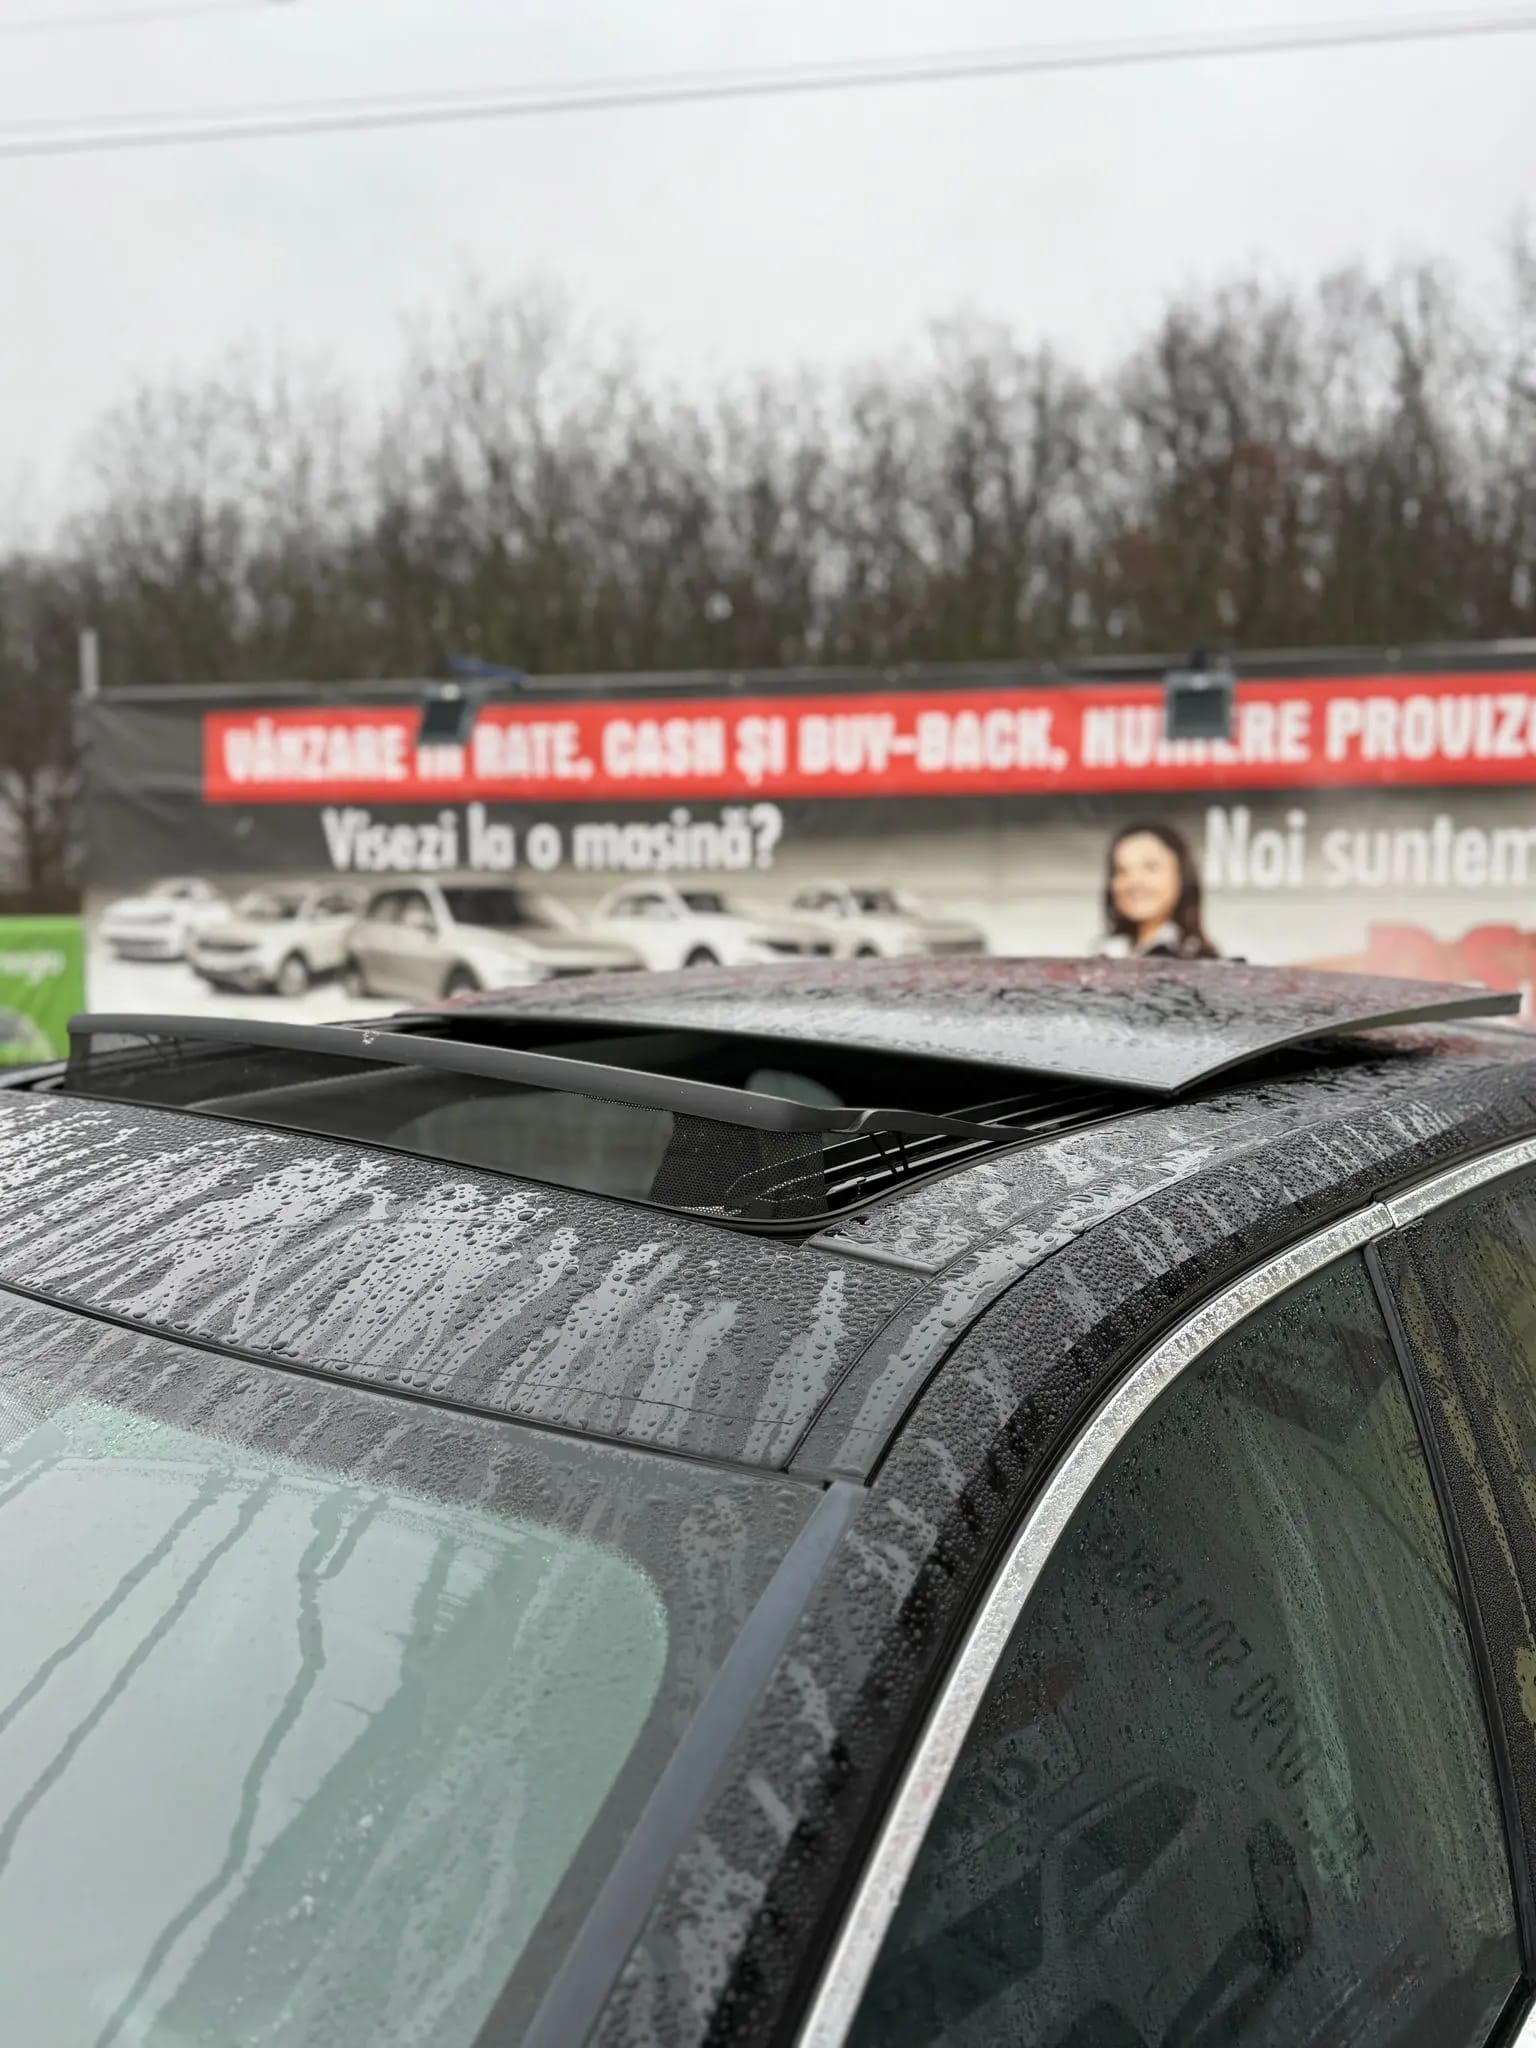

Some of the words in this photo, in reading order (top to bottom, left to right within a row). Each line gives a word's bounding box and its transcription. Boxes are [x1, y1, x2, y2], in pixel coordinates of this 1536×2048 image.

[602, 717, 725, 778] CASH
[1325, 693, 1536, 763] PROVIZ
[320, 806, 458, 871] Visezi
[466, 801, 515, 870] la
[525, 822, 562, 870] o
[1204, 804, 1308, 889] Noi
